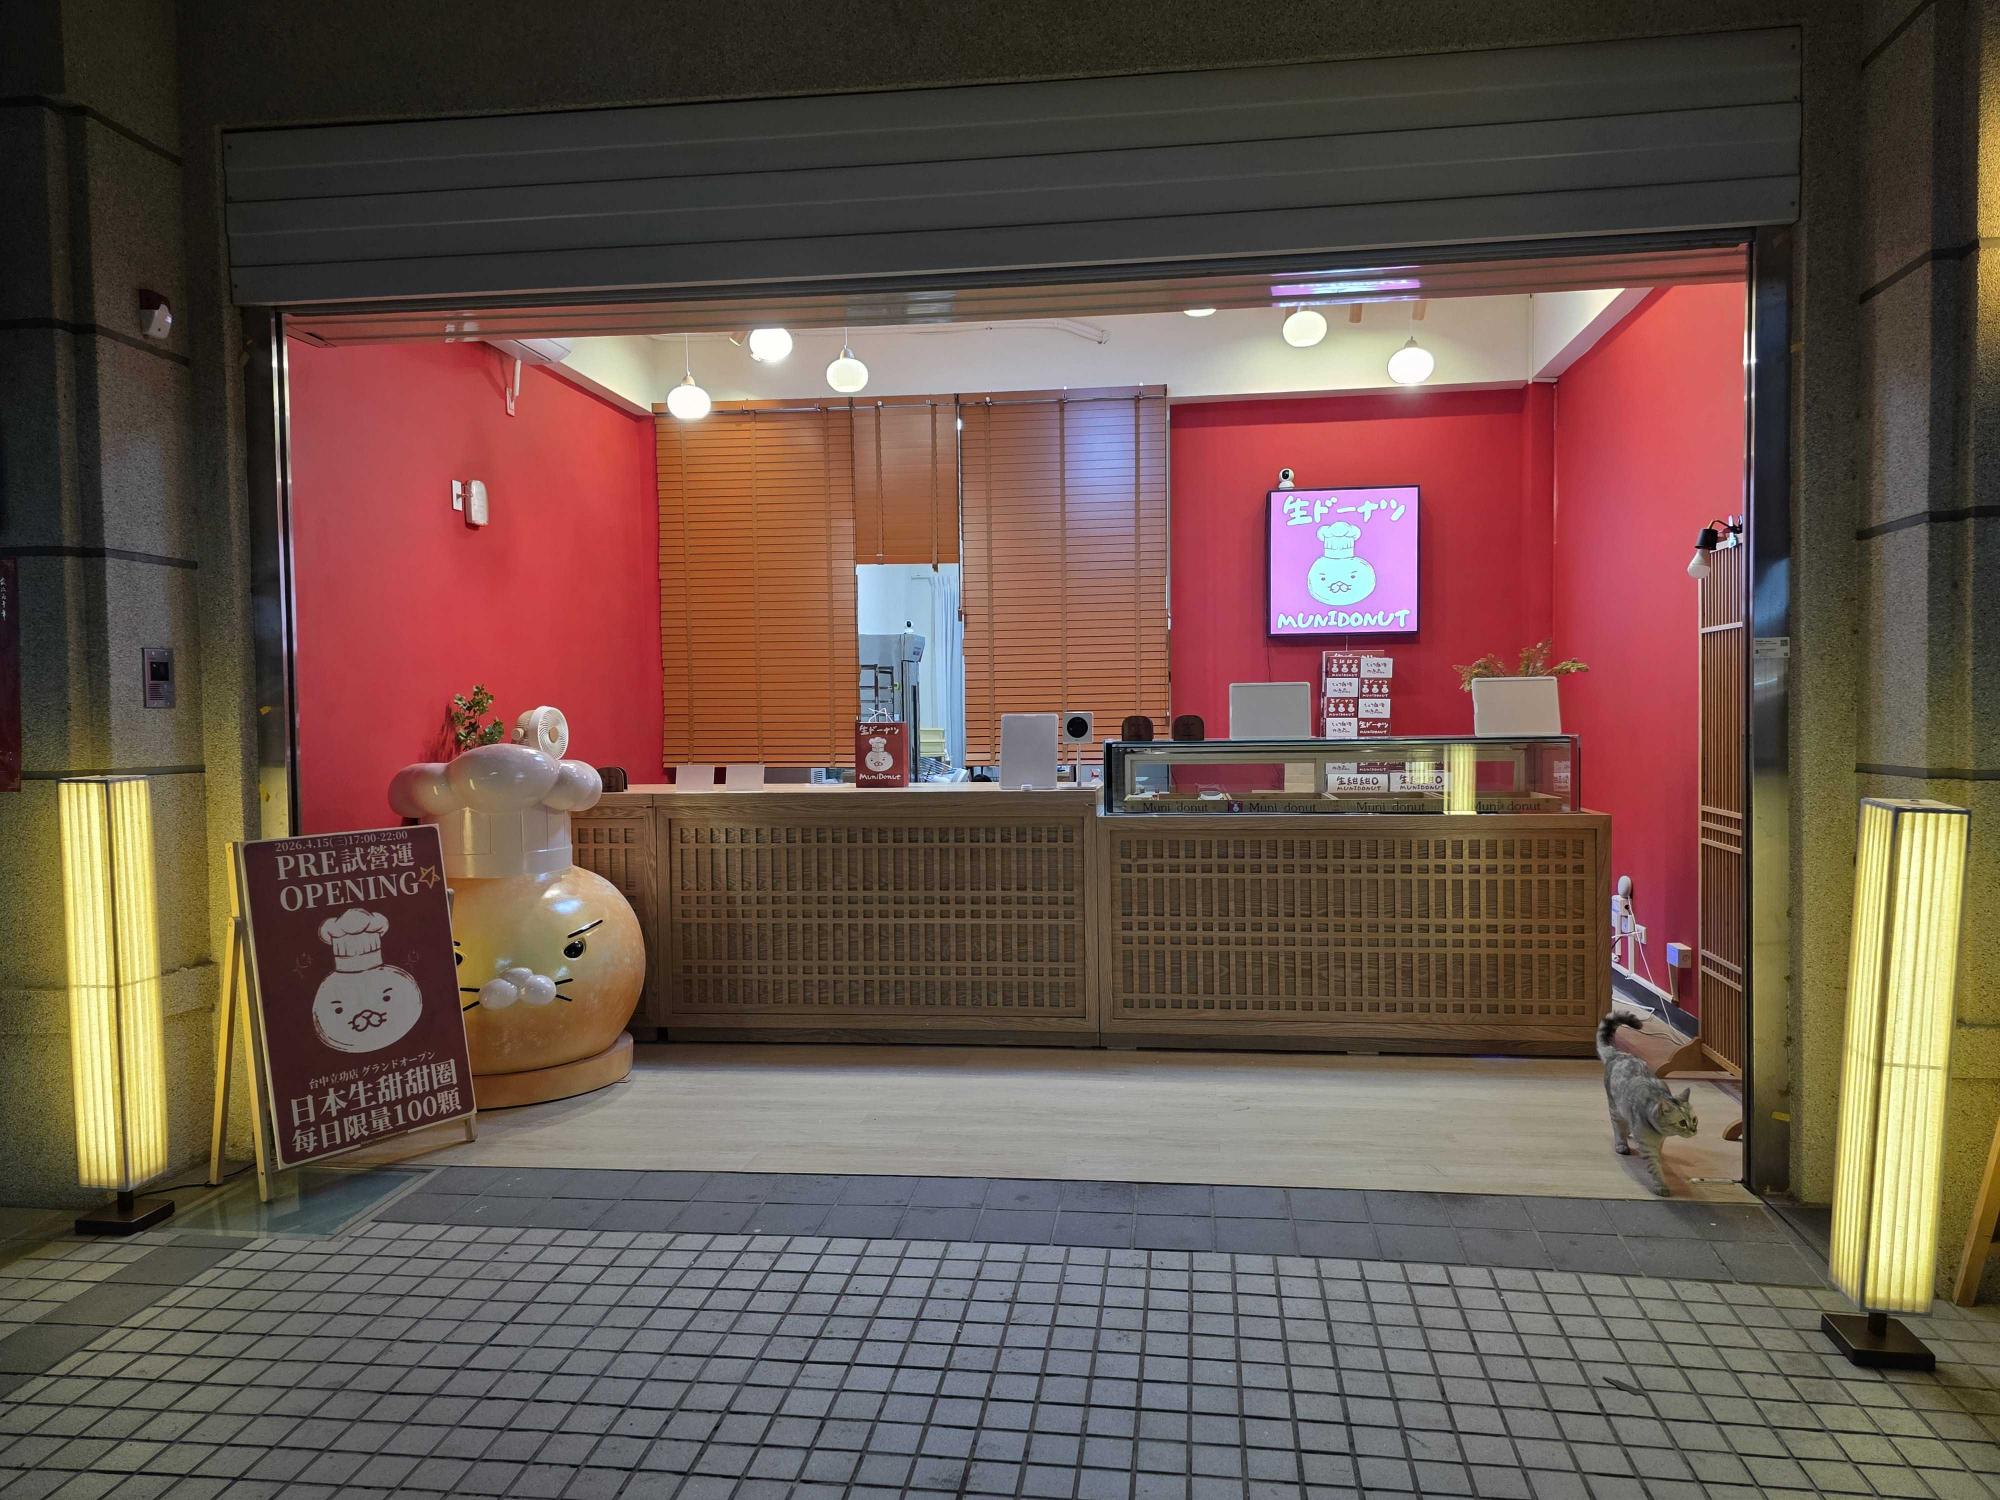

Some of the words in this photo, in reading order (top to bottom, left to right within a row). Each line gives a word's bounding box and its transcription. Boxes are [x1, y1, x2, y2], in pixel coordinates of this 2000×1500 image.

[1283, 495, 1406, 526] 生ドーナツ
[1277, 609, 1410, 629] MUNIDONUT
[859, 724, 900, 736] 生ドーナツ
[1143, 802, 1171, 812] Muni
[1176, 801, 1208, 812] donut
[1249, 802, 1278, 812] Muni
[1284, 801, 1316, 812] donut
[1356, 802, 1385, 812] Muni
[1392, 801, 1425, 812] donut
[1508, 801, 1541, 812] donut
[275, 830, 409, 853] 2026.4.15(三)17:00-22:00
[280, 871, 420, 912] OPENING
[291, 1058, 458, 1128] 日本生甜甜圈
[291, 1087, 462, 1154] 每日限量100顆
